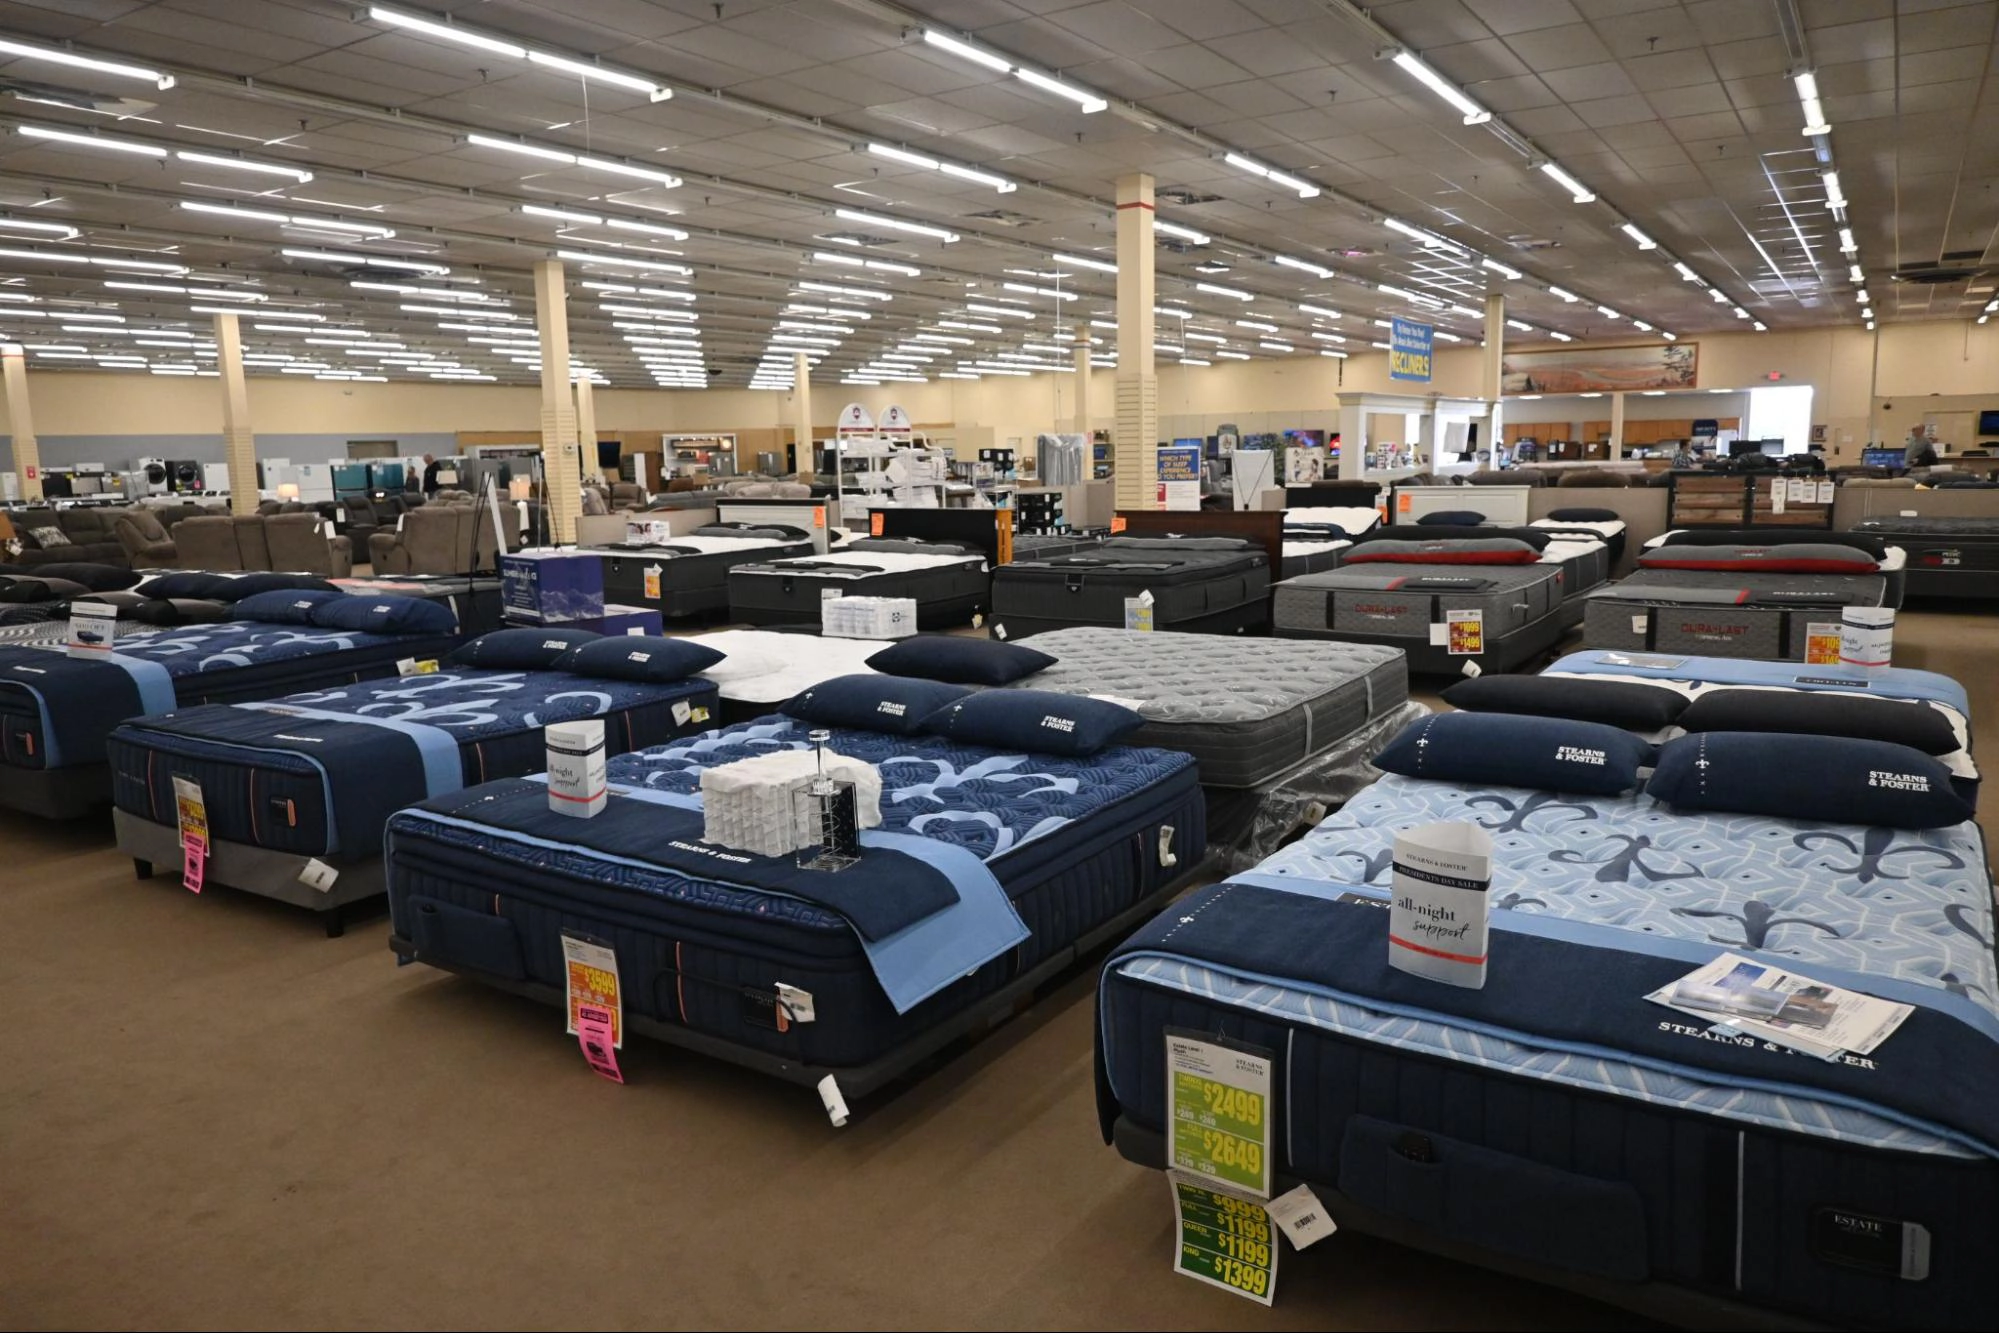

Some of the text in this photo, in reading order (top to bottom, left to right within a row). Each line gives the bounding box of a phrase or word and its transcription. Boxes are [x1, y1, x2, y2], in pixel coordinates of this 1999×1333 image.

[1555, 752, 1605, 765] & FOSTER
[1558, 746, 1605, 758] STEARNS
[1868, 778, 1930, 792] & FOSTER
[1869, 770, 1928, 784] STEARNS
[1406, 853, 1433, 864] STEARNS
[1440, 862, 1467, 871] FOSTER
[1400, 865, 1479, 889] PRESIDENTS DAY SALE
[1398, 896, 1455, 922] all-night
[1412, 919, 1471, 941] support
[1763, 1042, 1778, 1053] &
[1203, 1082, 1260, 1126] $2499
[1203, 1130, 1260, 1175] $2649
[1212, 1193, 1266, 1222] $999
[1183, 1221, 1208, 1233] QUEEN
[1217, 1212, 1268, 1242] $1199
[1835, 1213, 1882, 1232] ESTATE
[1218, 1233, 1268, 1267] $1199
[1214, 1256, 1267, 1294] $1399
